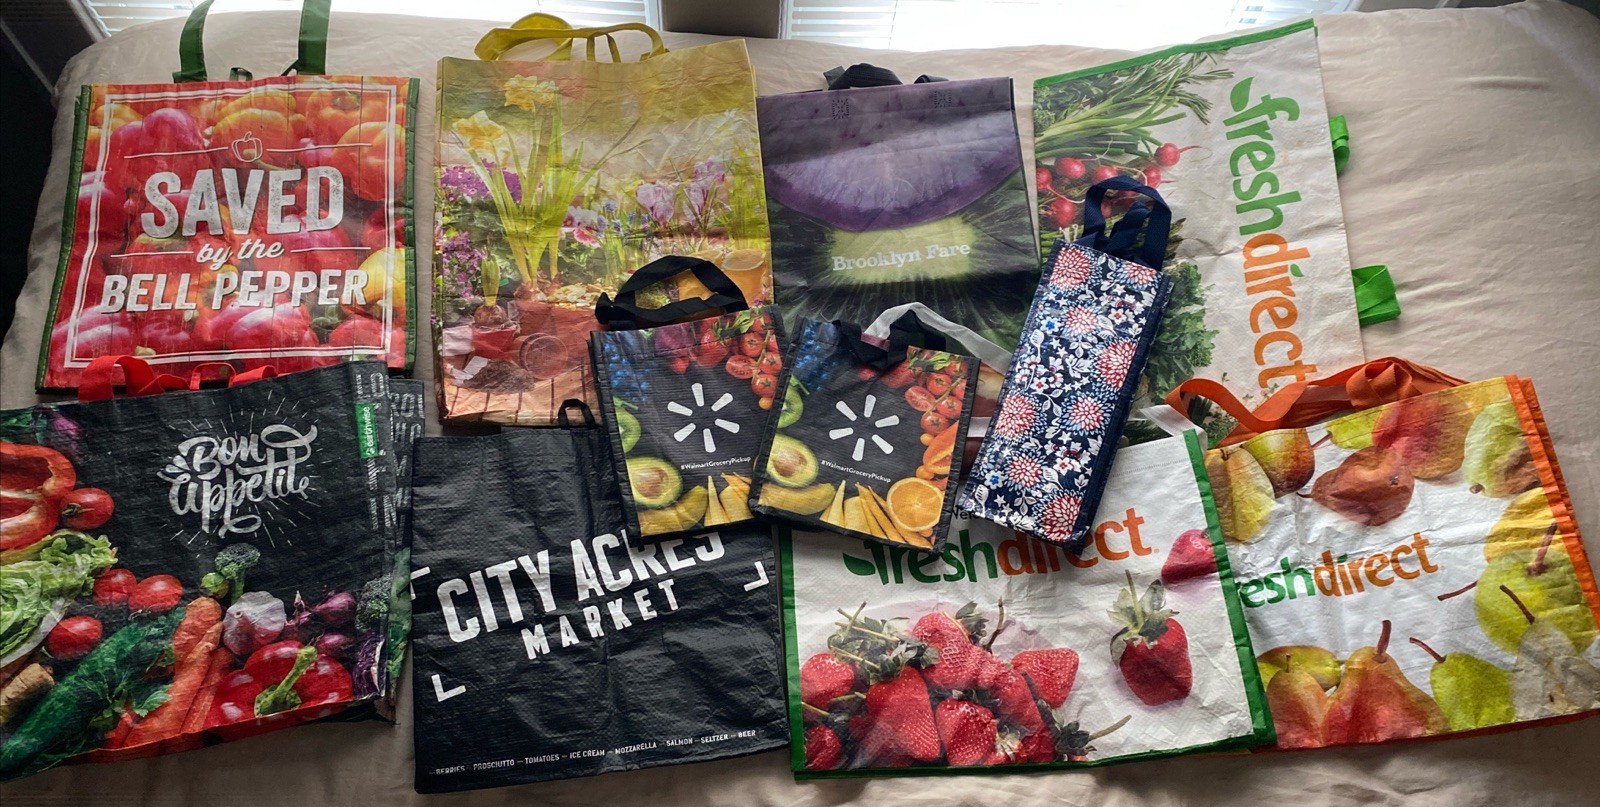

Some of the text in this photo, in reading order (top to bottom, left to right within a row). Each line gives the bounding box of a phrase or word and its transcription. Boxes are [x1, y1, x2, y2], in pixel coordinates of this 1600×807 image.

[140, 166, 344, 240] SAVED
[195, 238, 284, 270] by the
[831, 243, 971, 272] Brooklyn Fare
[1222, 94, 1318, 389] freshdirect
[100, 269, 368, 314] BELL PEPPER
[364, 406, 375, 447] earthwise
[177, 433, 267, 480] Bon
[680, 456, 752, 470] #WalmartGroceryPickup
[820, 459, 892, 483] #WalmartGroceryPickup
[1236, 531, 1439, 609] eshdirect
[436, 549, 557, 643] CITY
[520, 578, 680, 661] MARKET
[435, 729, 756, 775] BERRIES PROSCIUTTO TOMATOES ICE CREAM MOZZARELLA SALMON SELTZER BEER
